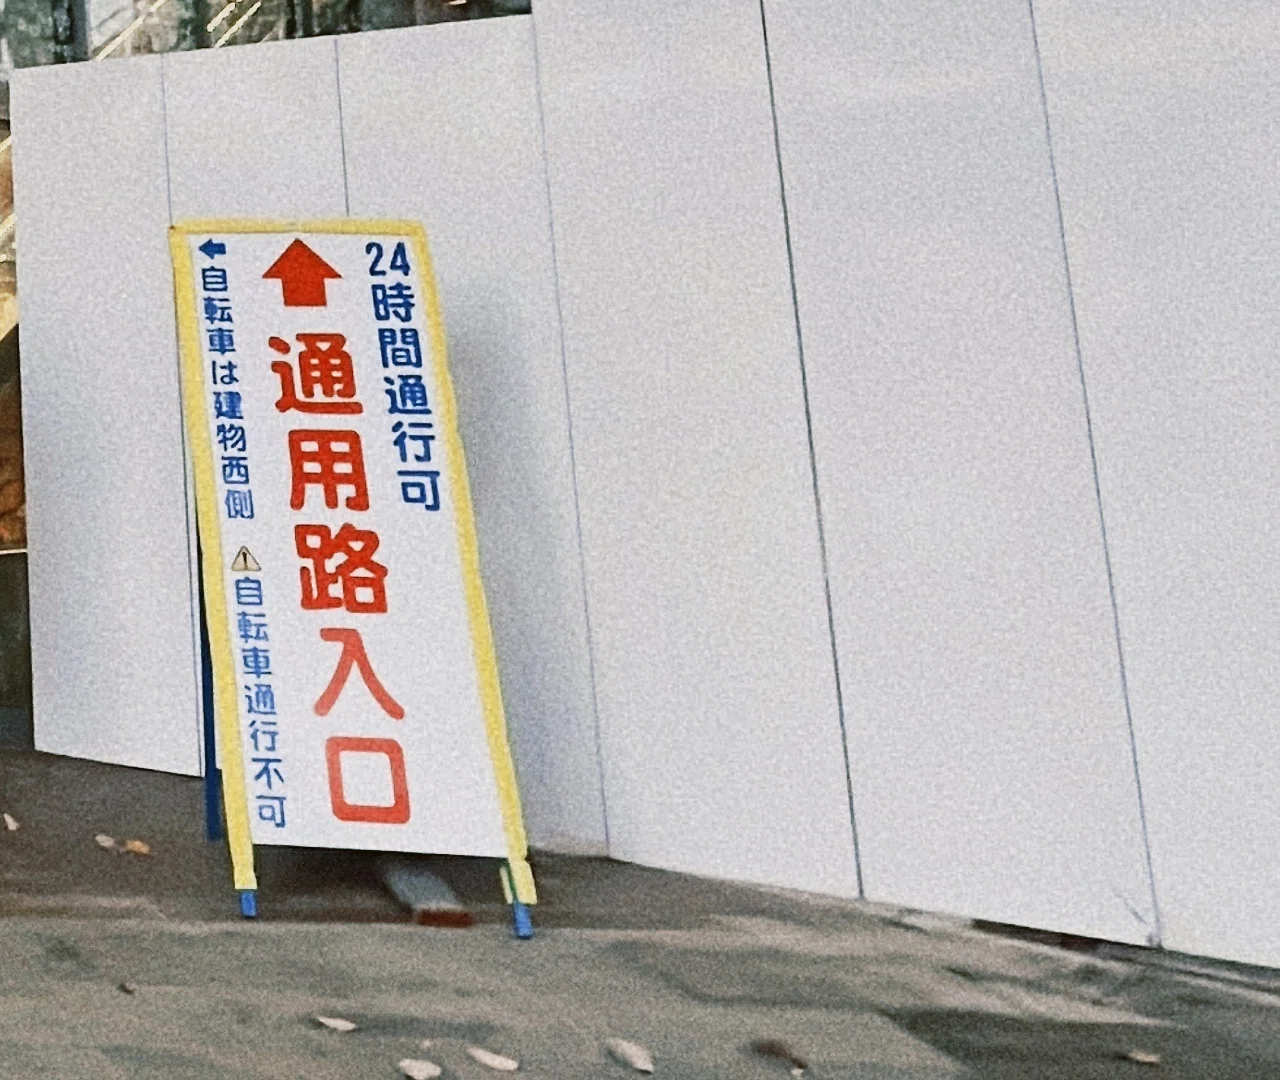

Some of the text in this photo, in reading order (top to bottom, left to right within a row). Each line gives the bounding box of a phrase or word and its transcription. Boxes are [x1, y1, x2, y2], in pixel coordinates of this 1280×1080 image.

[201, 266, 255, 520] 自転車は建物西側
[365, 241, 441, 512] 24時間通行可
[235, 576, 287, 829] 自転車通行不可
[268, 332, 411, 825] 通用路入口
